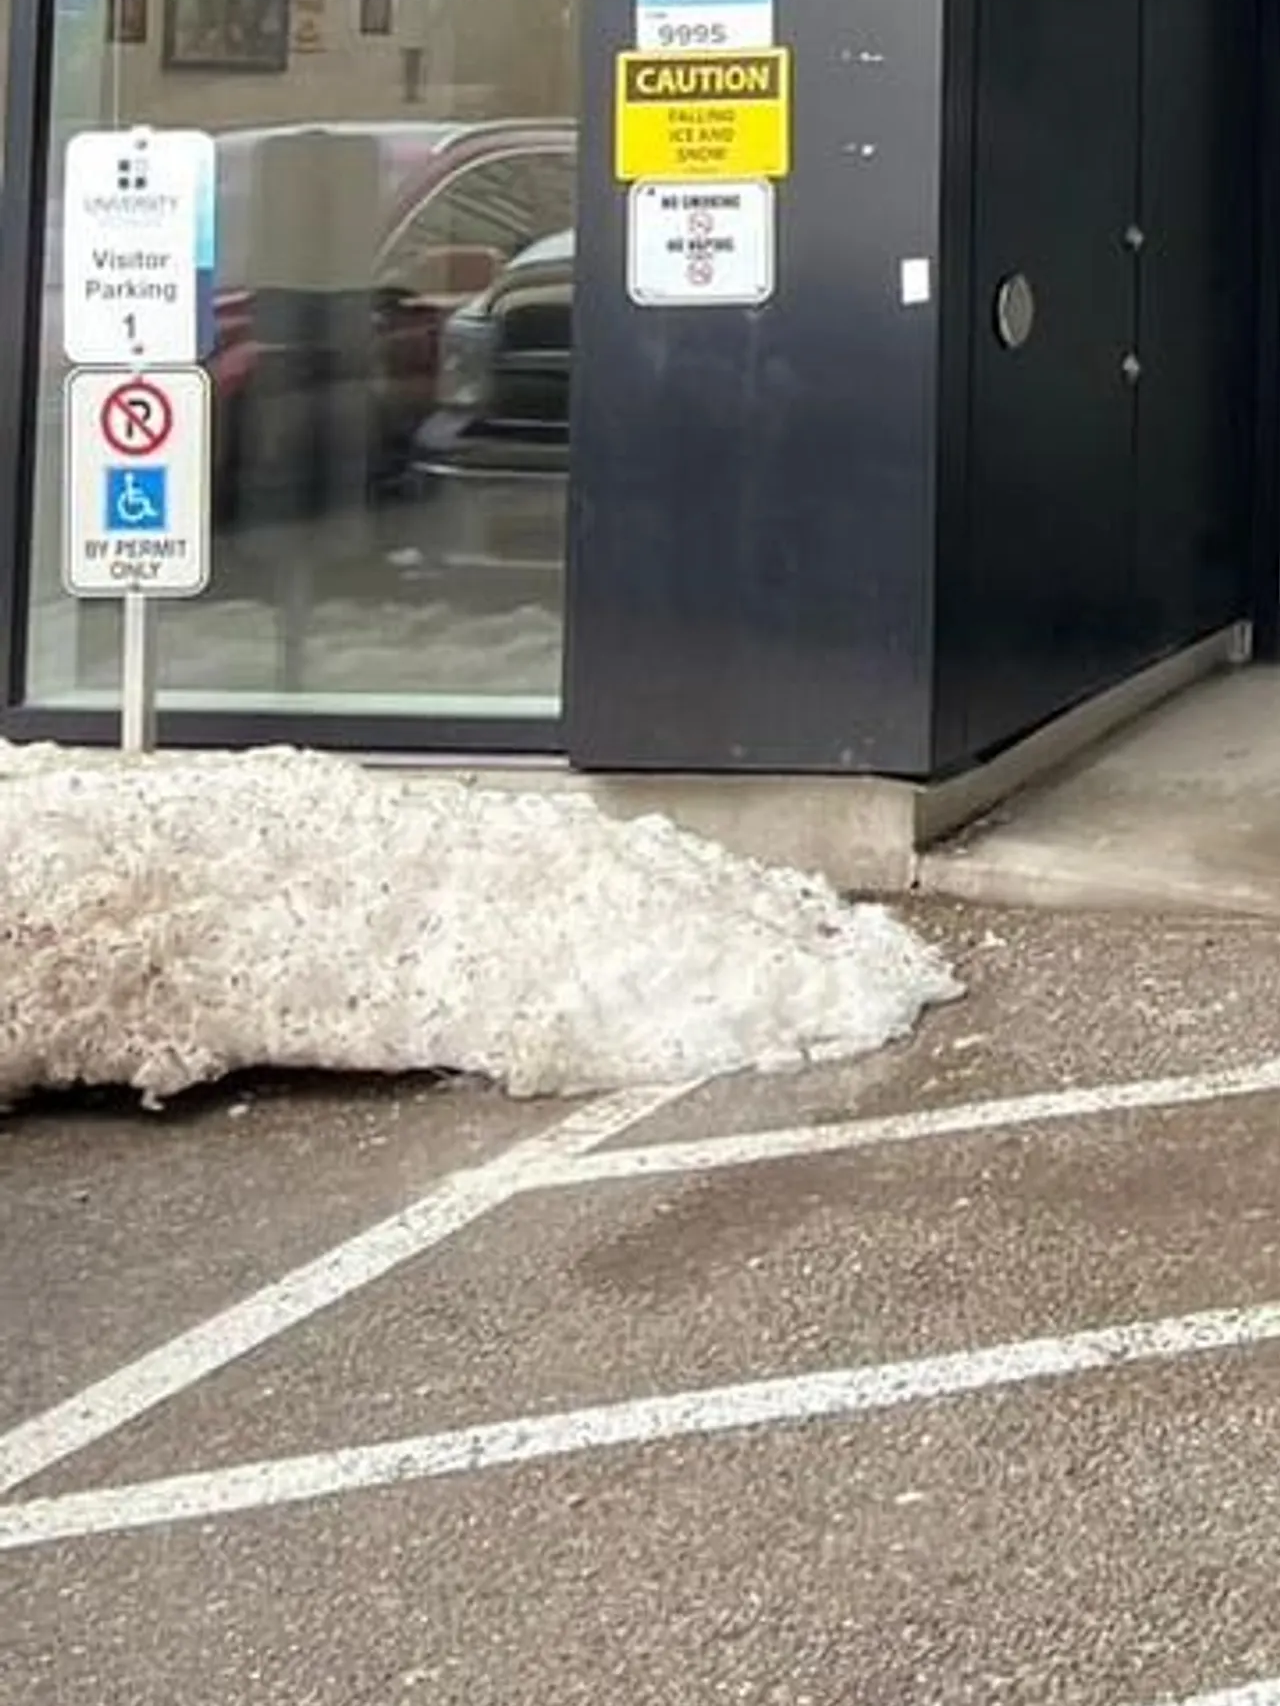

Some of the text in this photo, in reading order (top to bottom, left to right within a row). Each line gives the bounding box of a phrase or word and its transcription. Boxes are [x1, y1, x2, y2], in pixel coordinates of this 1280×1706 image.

[636, 65, 770, 95] CAUTION
[92, 247, 171, 271] Visitor
[85, 278, 179, 303] Parking
[122, 312, 136, 339] 1
[85, 538, 187, 559] BY PERMIT
[110, 560, 162, 580] ONLY
